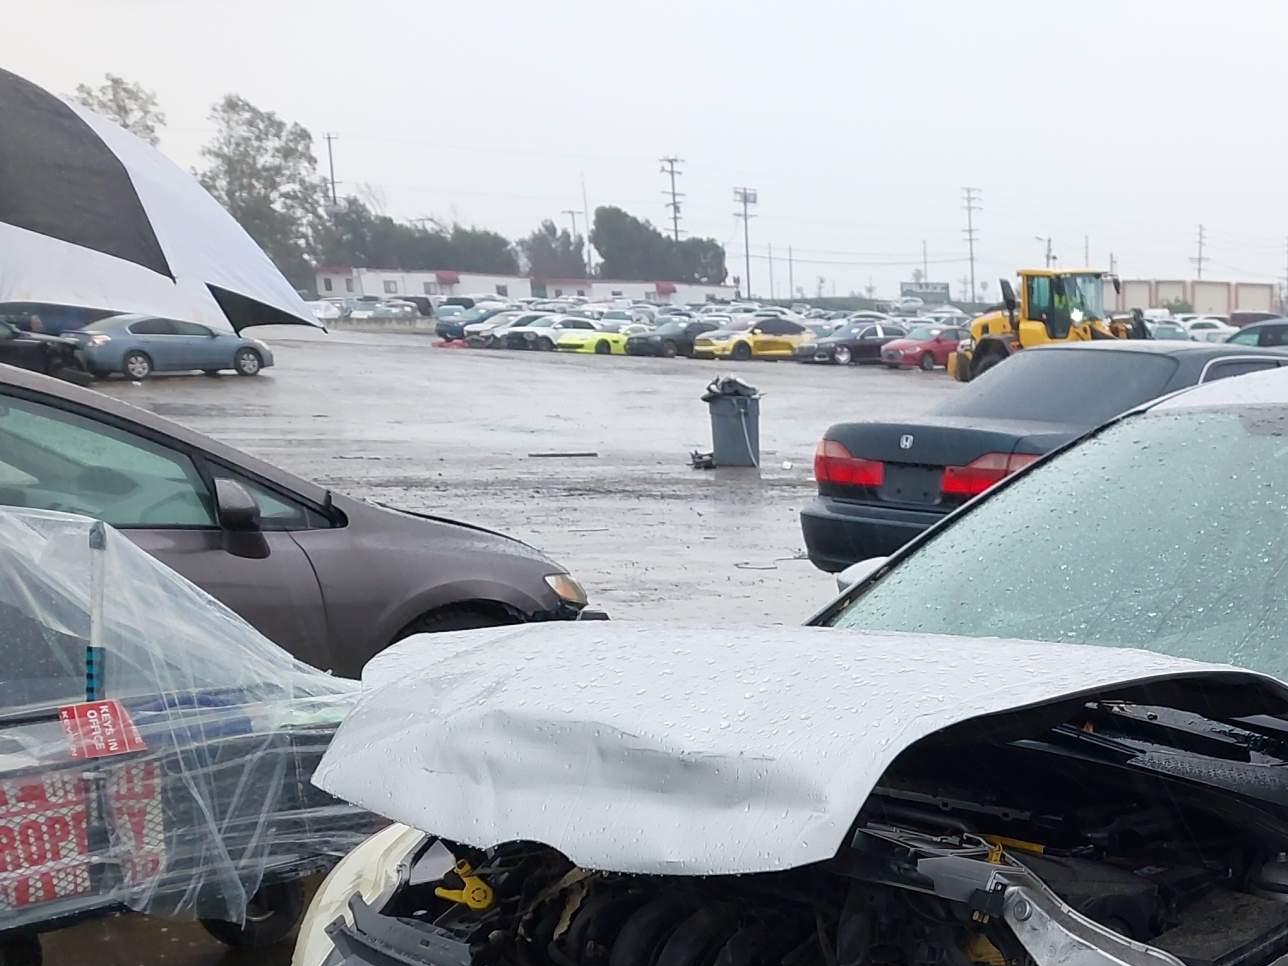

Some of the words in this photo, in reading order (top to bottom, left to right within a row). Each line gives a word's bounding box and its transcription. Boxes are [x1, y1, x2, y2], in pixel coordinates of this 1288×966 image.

[86, 709, 106, 750] OFFICE
[99, 705, 114, 736] KEYS
[108, 738, 119, 751] IN
